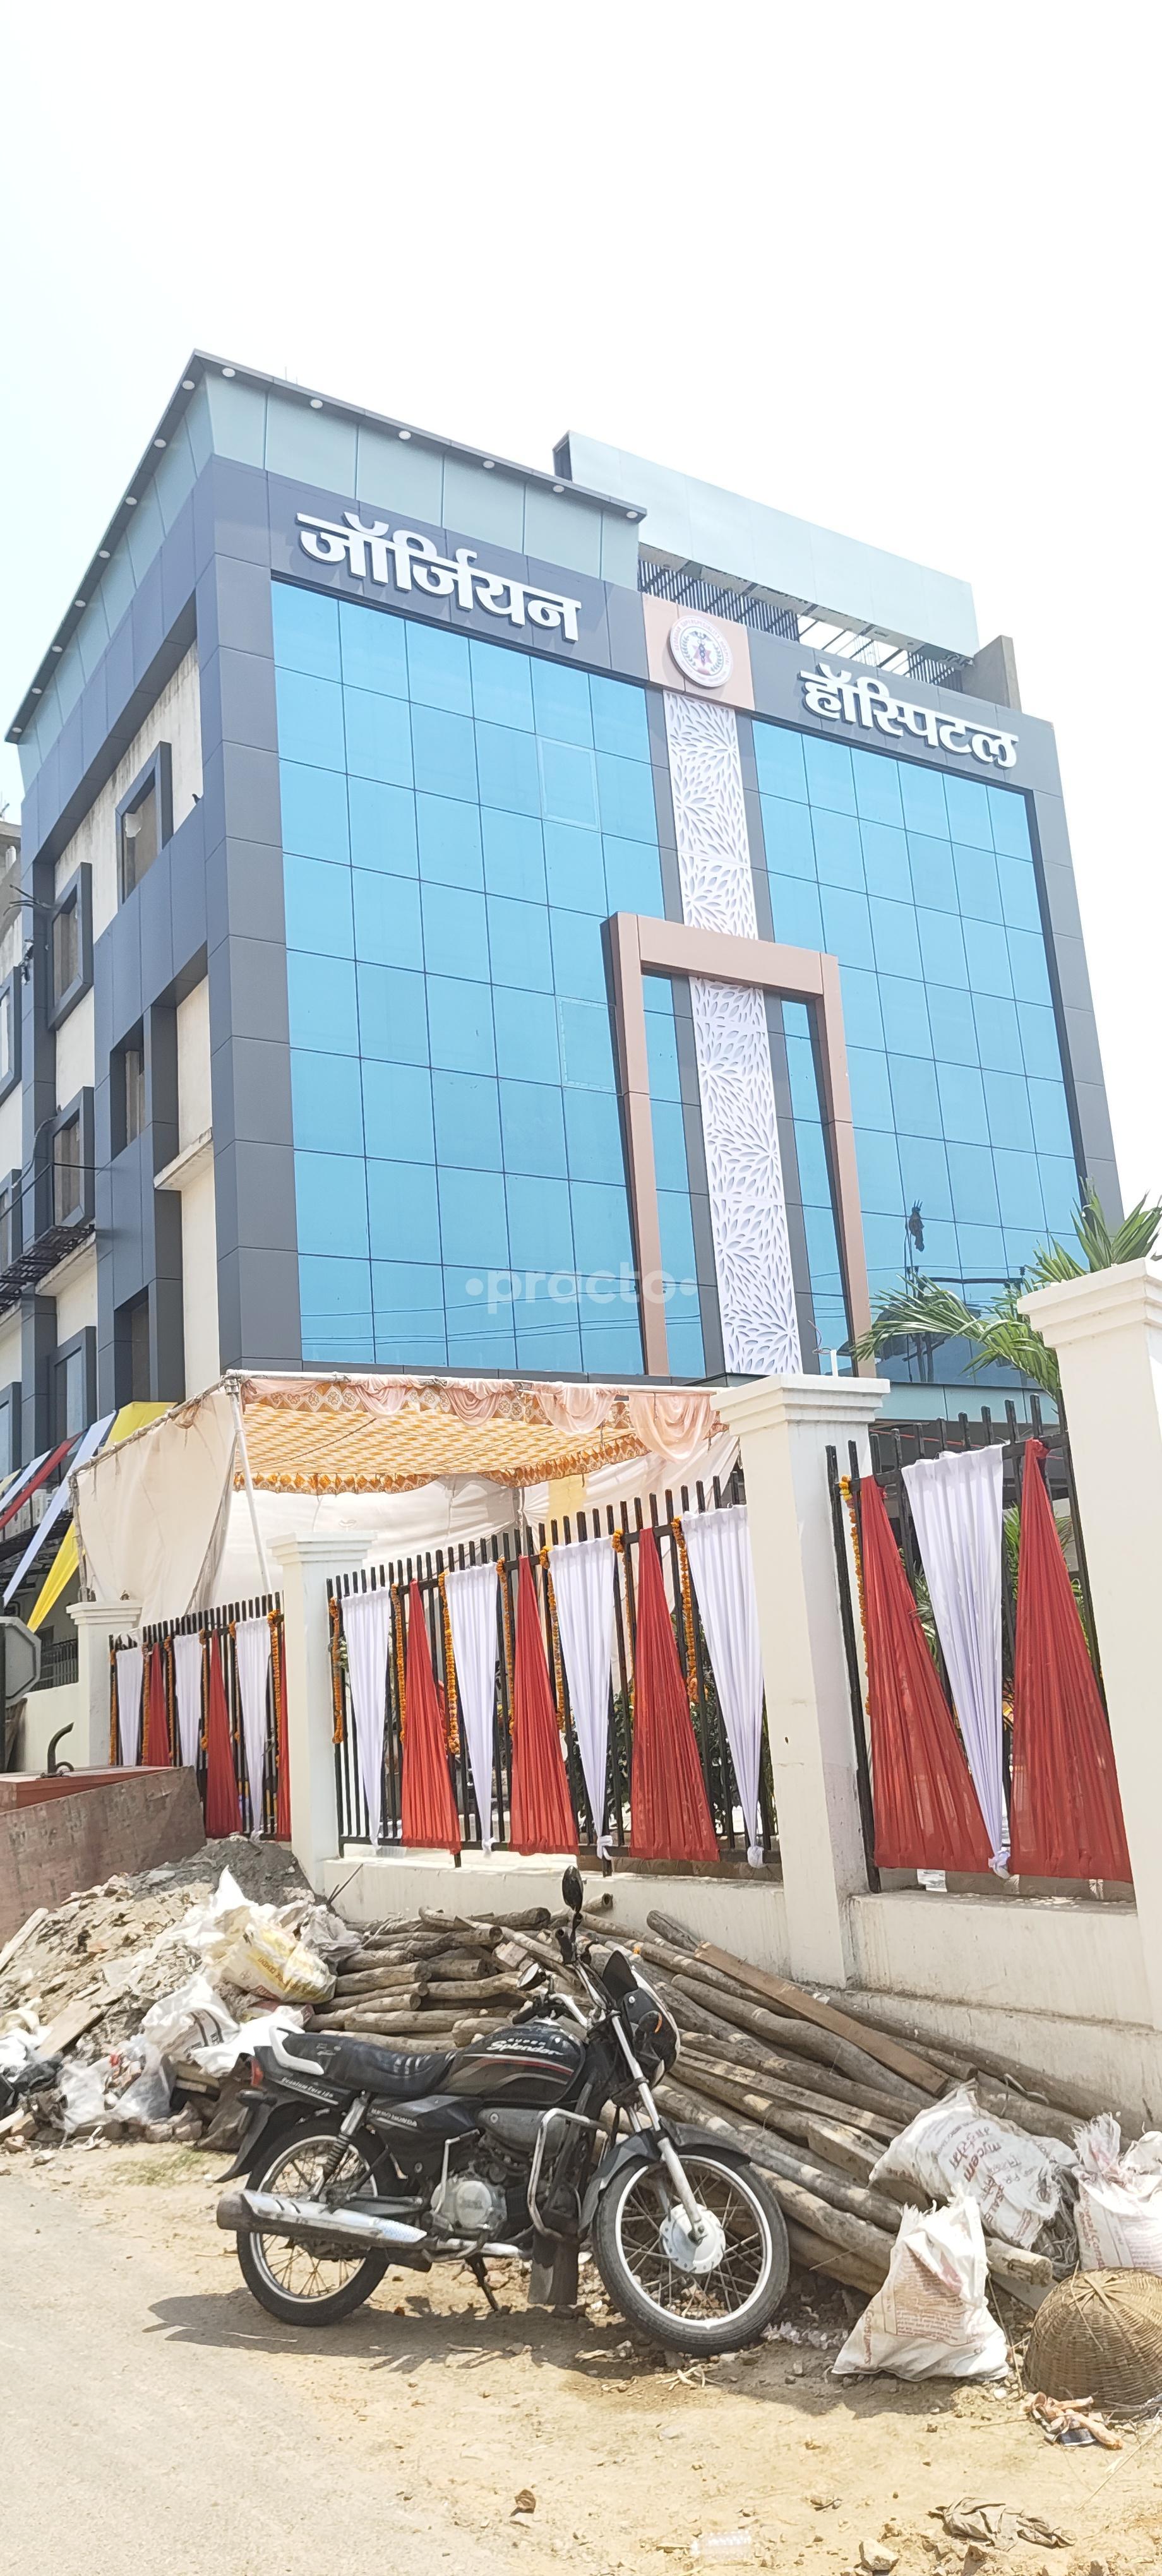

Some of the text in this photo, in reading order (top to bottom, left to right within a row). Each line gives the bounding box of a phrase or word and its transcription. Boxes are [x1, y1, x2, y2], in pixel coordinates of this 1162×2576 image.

[296, 511, 582, 643] जॉर्जियन
[800, 662, 1019, 768] हॉस्पिटल
[486, 2040, 565, 2055] Splendor
[963, 2141, 1002, 2183] mycem
